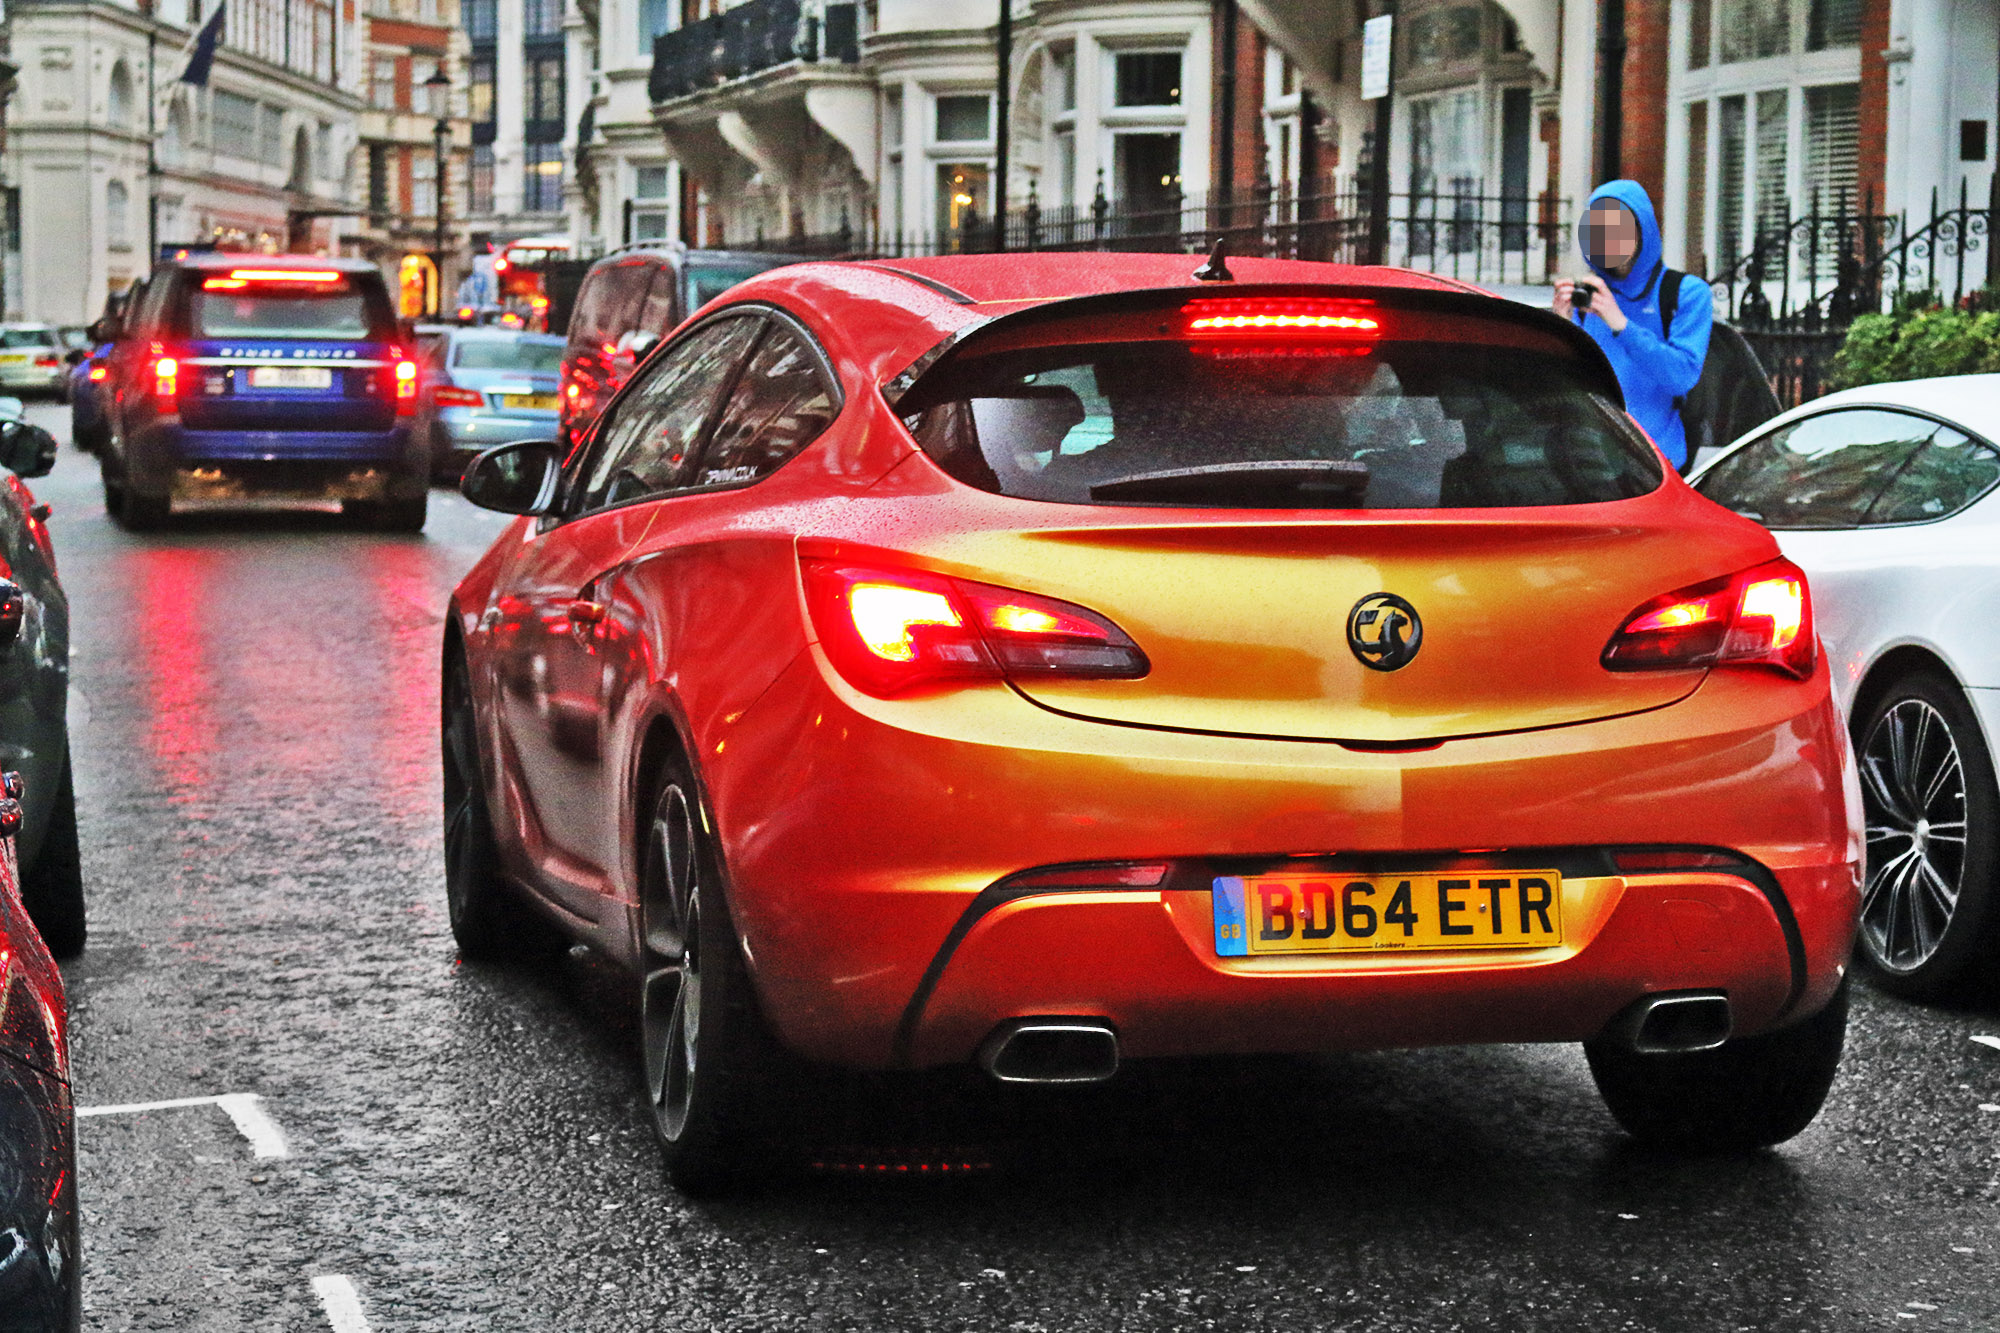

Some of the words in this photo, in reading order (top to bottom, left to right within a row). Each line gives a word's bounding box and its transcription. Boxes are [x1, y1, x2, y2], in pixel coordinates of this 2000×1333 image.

[1257, 881, 1419, 941] BD64
[1438, 877, 1554, 936] ETR
[1220, 923, 1241, 939] GB
